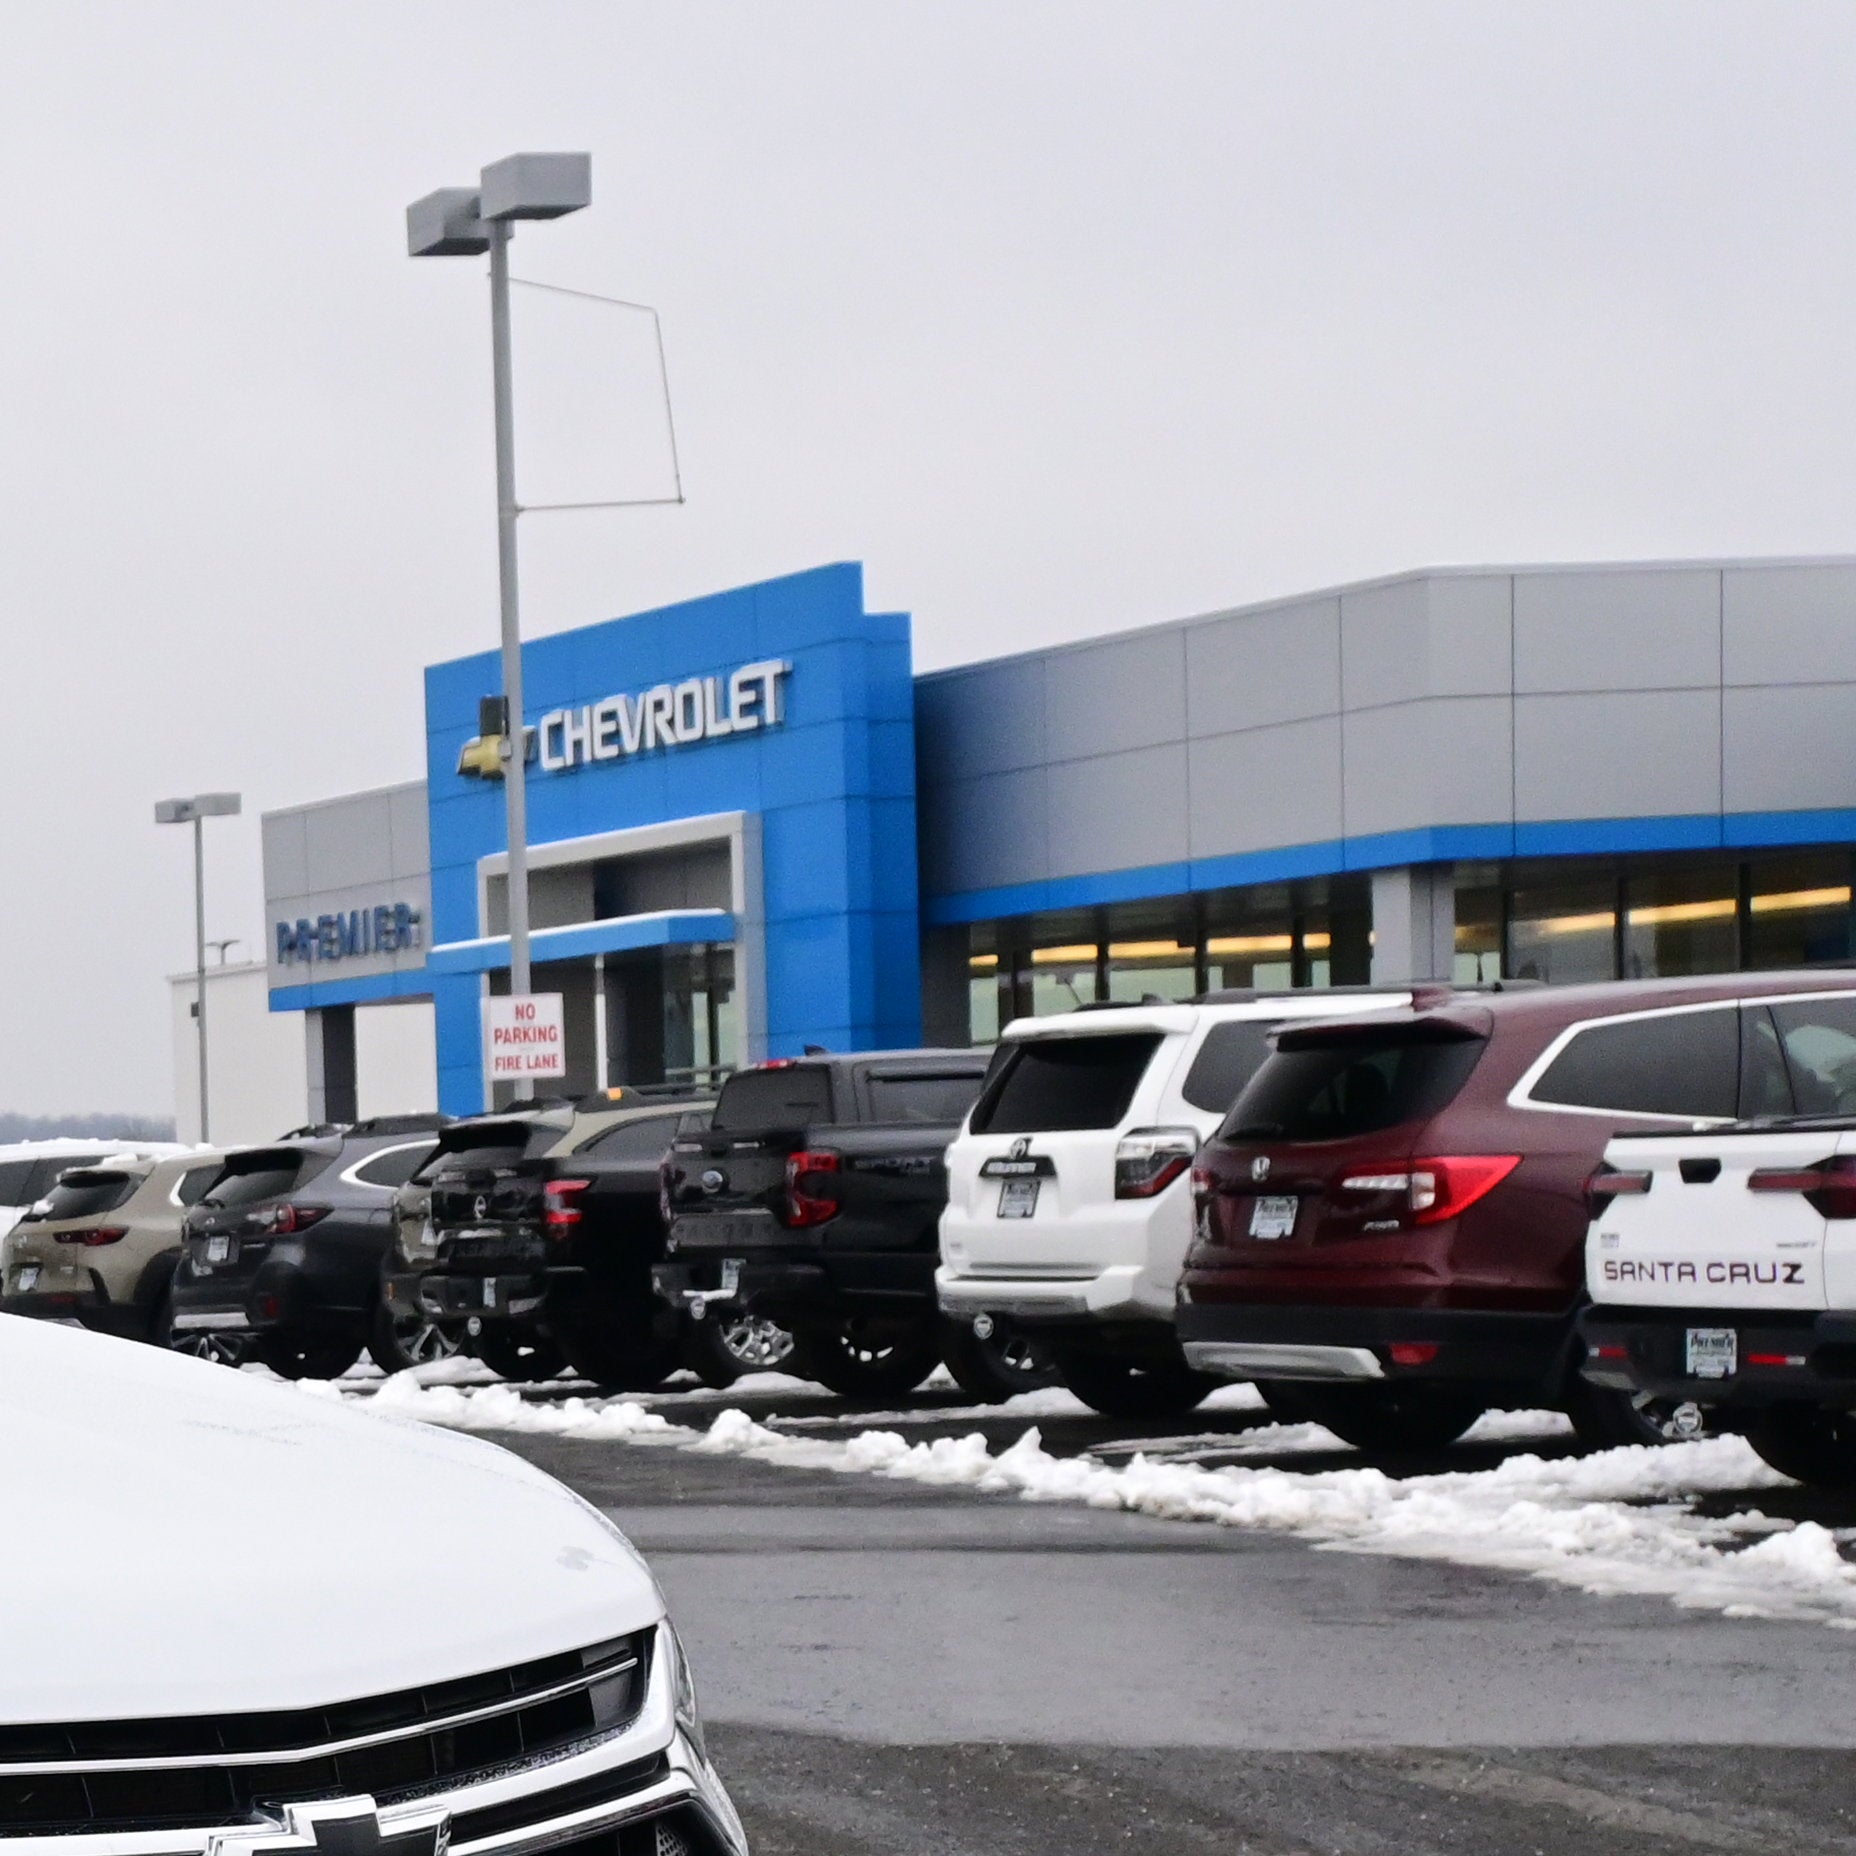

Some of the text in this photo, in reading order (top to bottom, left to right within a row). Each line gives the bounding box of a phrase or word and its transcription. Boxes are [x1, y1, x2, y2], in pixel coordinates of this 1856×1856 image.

[540, 658, 789, 772] CHEVROLET
[276, 902, 420, 965] PREMIER
[514, 1002, 536, 1021] NO
[493, 1025, 558, 1045] PARKING
[494, 1053, 559, 1072] FIRE LANE
[1603, 1260, 1805, 1285] SANTA CRUZ
